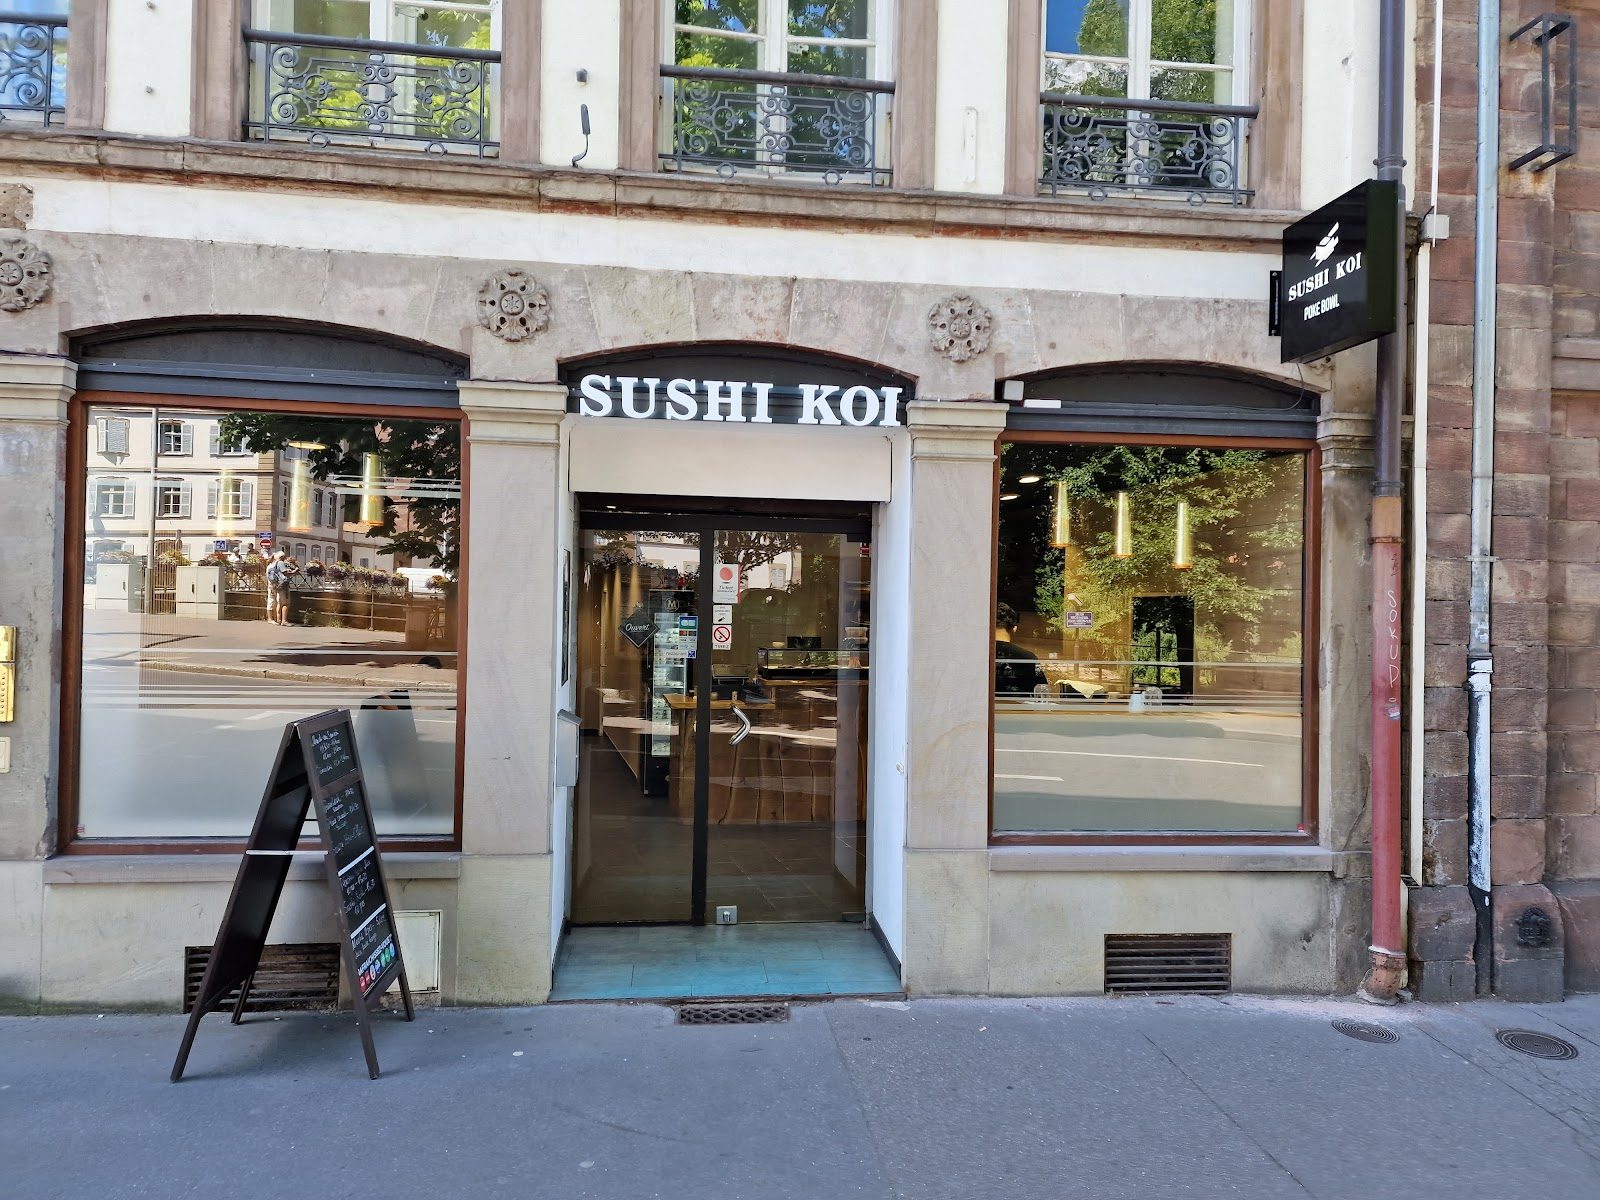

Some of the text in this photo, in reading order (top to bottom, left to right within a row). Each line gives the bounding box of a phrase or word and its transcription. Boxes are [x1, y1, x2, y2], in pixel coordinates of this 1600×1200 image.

[1288, 251, 1362, 302] SUSHI KOI
[1303, 293, 1340, 321] POKE BOWL
[579, 374, 903, 427] SUSHI KOI
[625, 623, 650, 632] Ouvert
